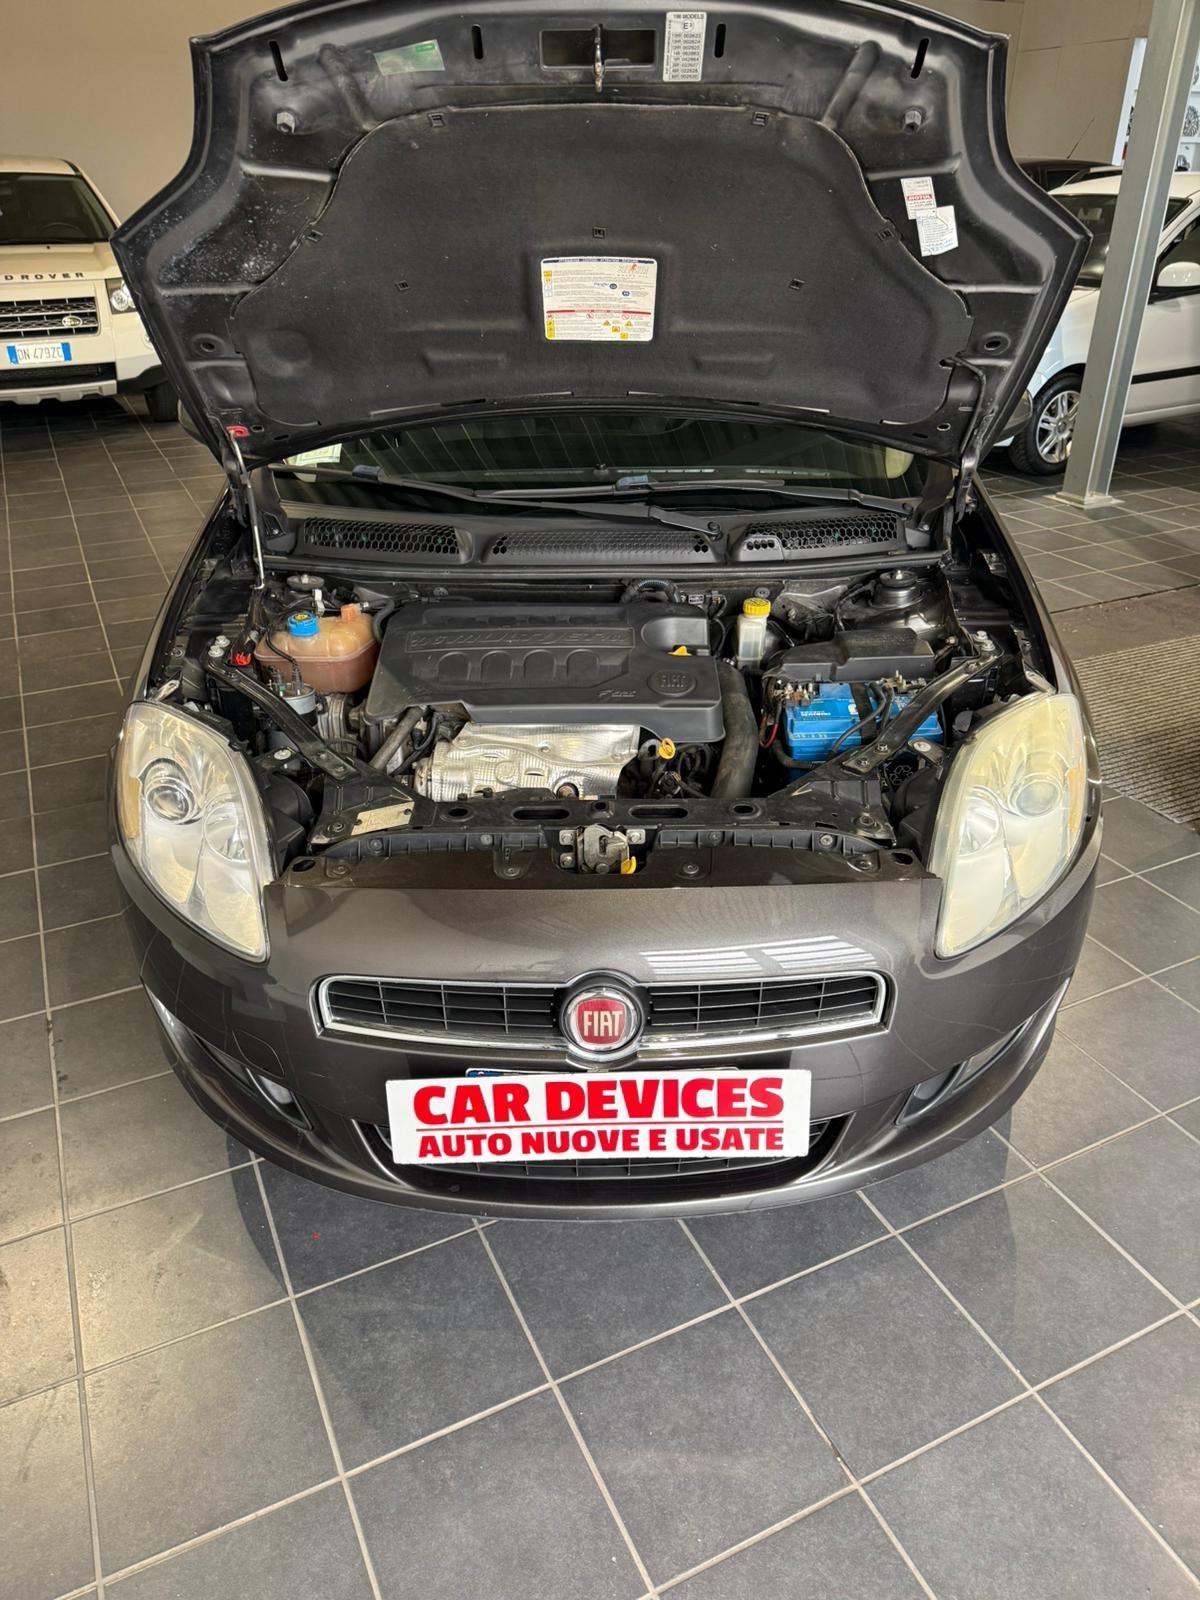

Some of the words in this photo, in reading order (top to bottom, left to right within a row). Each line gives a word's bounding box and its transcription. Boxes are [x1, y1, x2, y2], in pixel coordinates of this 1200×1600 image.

[583, 1010, 623, 1037] FIAT
[414, 1084, 531, 1124] CAR
[546, 1078, 784, 1121] DEVICES
[420, 1132, 512, 1158] AUTO
[522, 1129, 640, 1155] NUOVE
[650, 1129, 667, 1151] E
[677, 1127, 784, 1151] USATE
